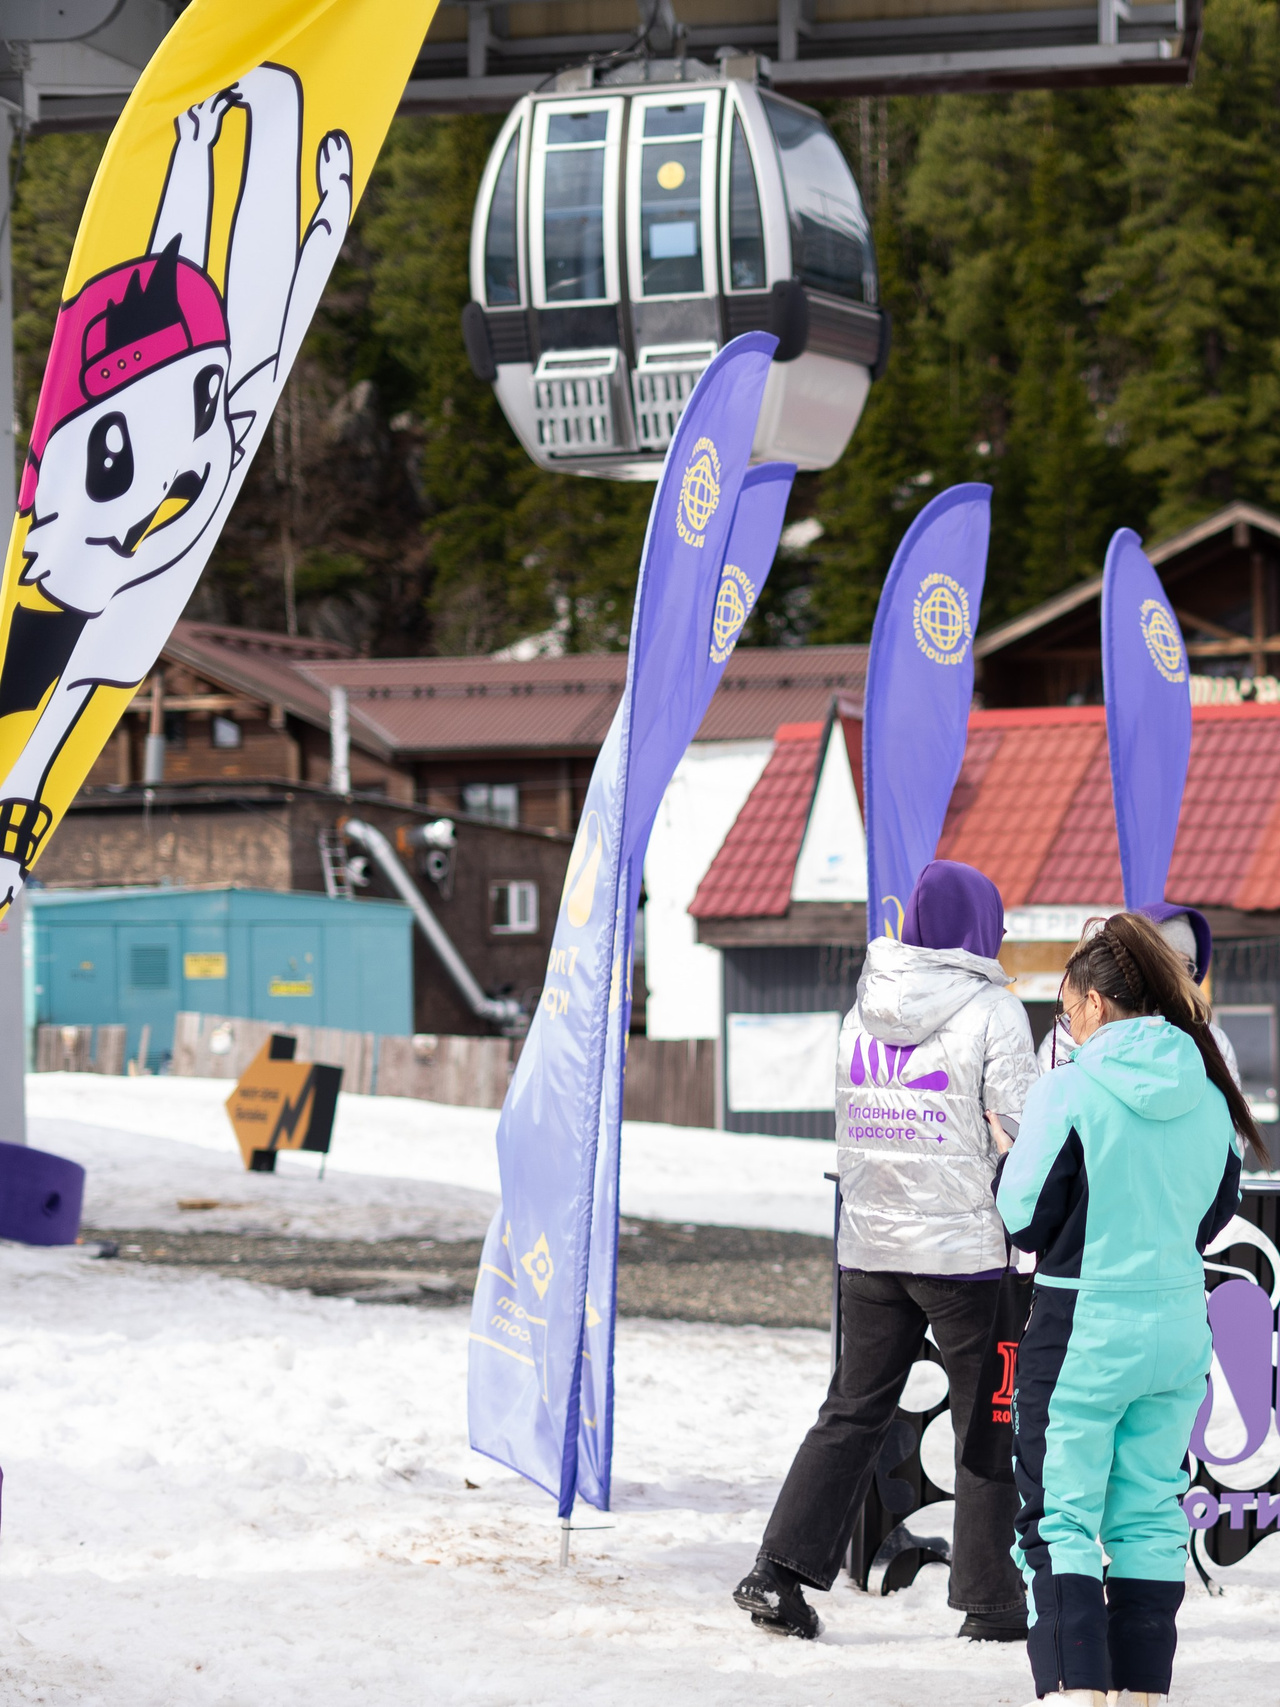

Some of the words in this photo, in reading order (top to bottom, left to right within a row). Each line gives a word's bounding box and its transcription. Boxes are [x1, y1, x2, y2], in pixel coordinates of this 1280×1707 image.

[848, 1104, 917, 1121] Главные
[922, 1110, 947, 1123] по
[848, 1126, 916, 1142] красоте
